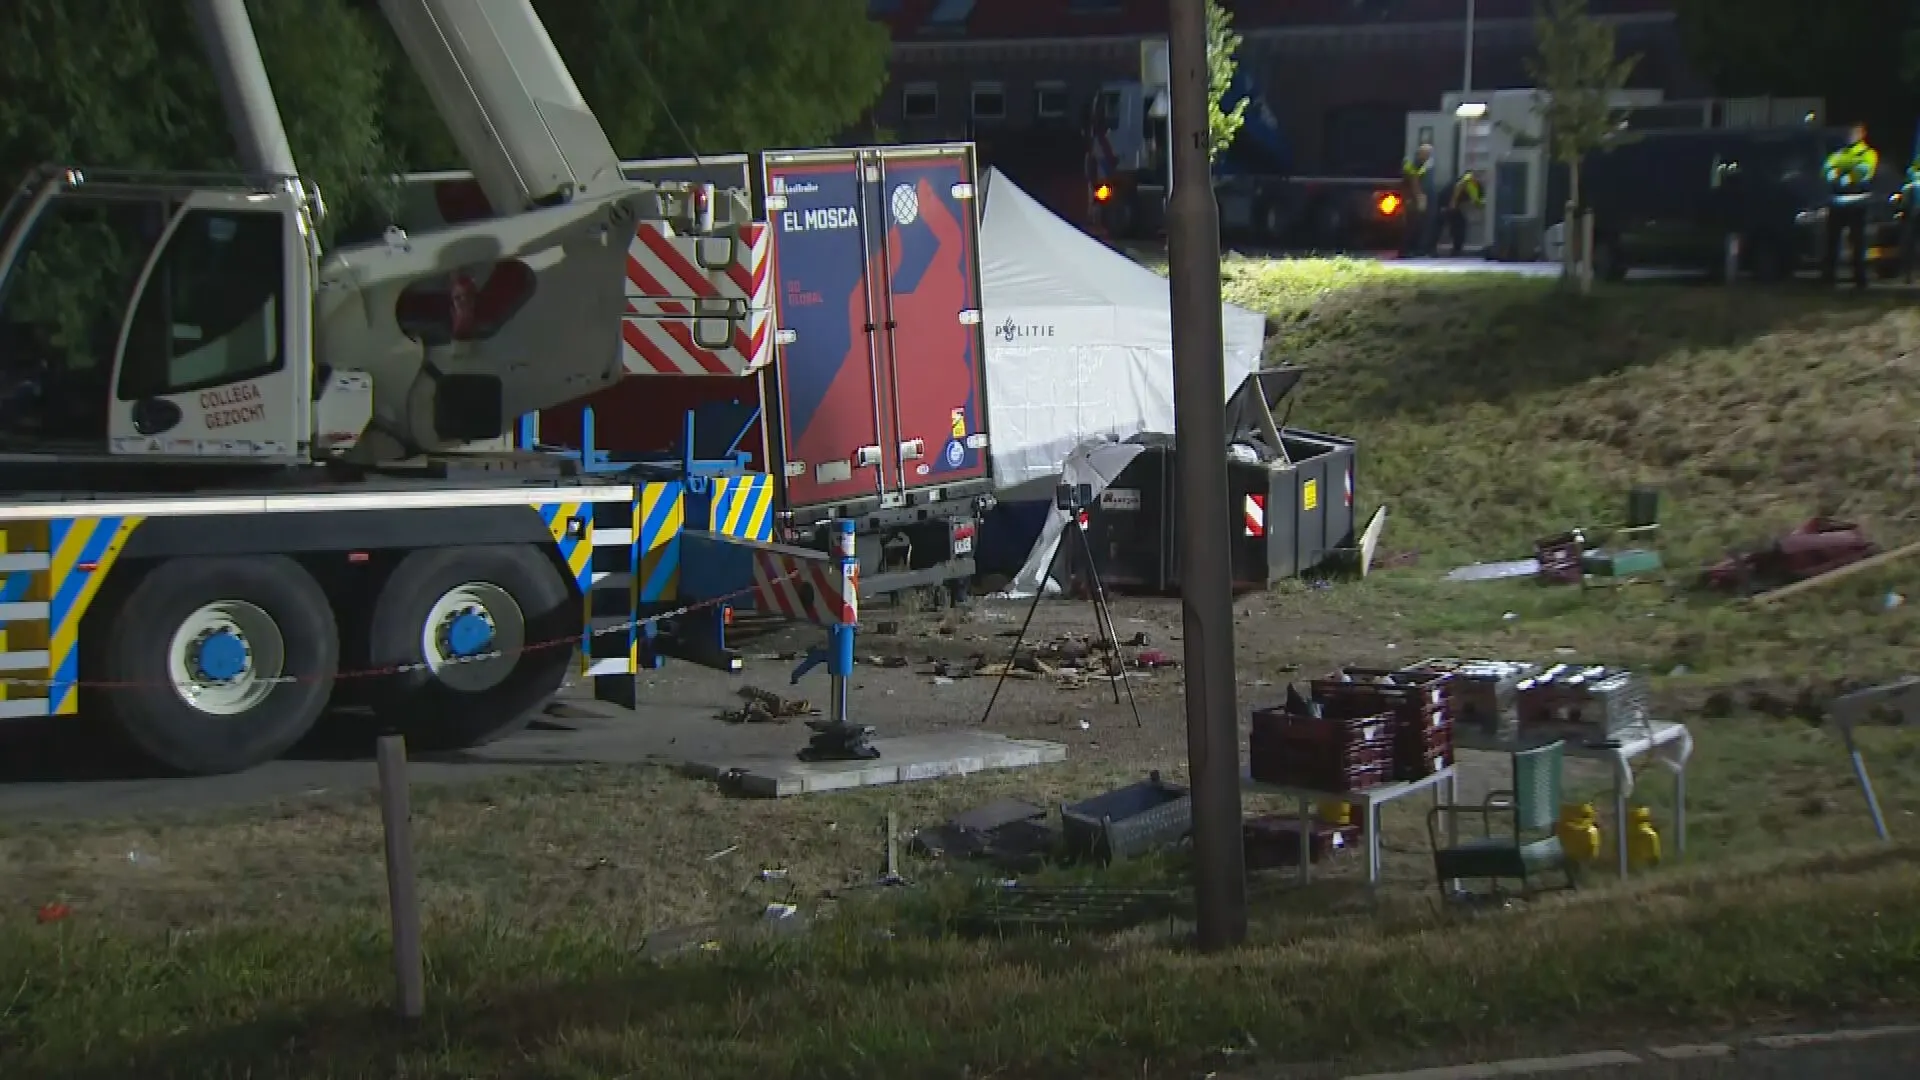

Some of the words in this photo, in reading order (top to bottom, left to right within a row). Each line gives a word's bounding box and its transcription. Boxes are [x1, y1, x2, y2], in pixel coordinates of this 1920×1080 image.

[783, 210, 804, 232] EL
[804, 206, 859, 231] MOSCA
[200, 384, 261, 409] COLLEGA
[205, 403, 265, 430] GEZOCHT
